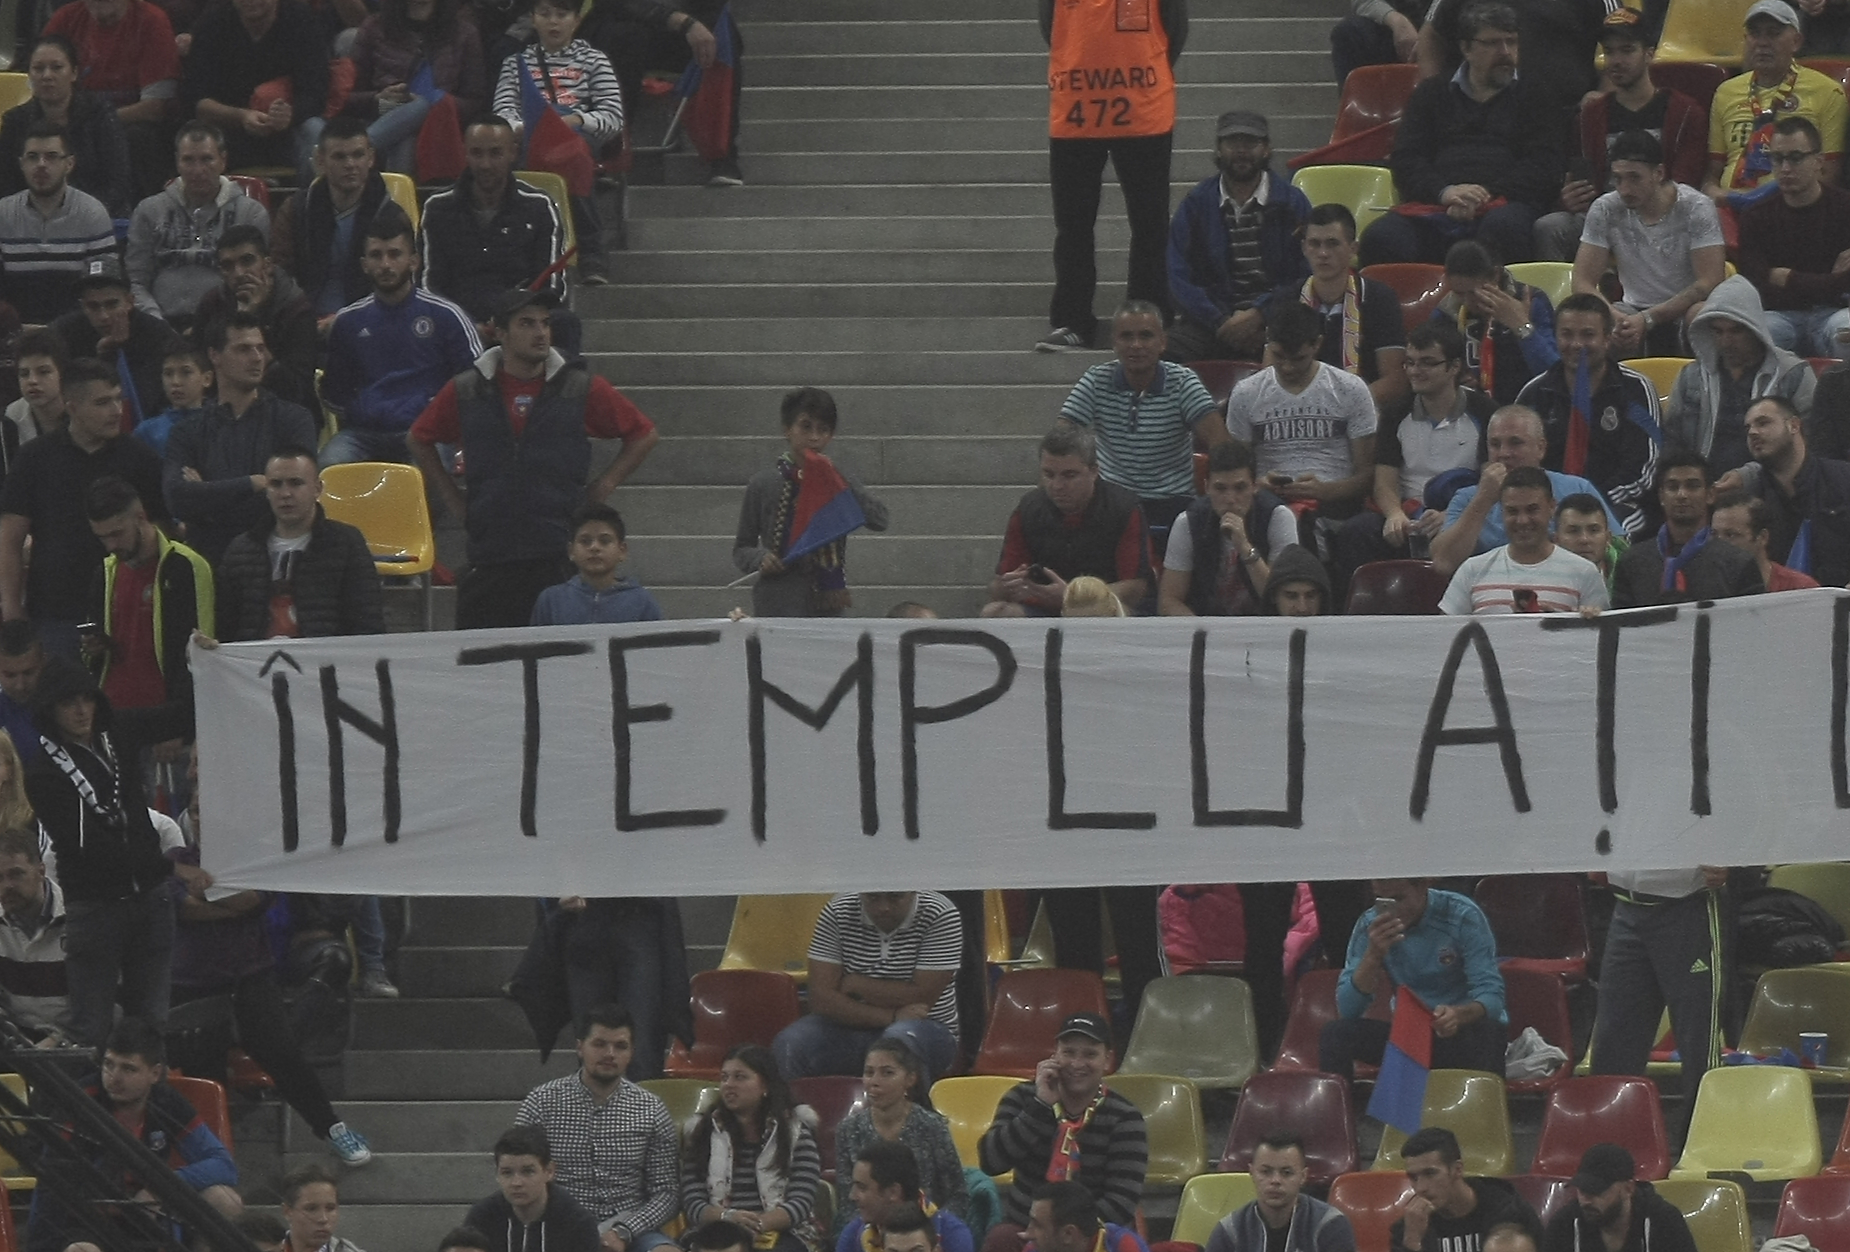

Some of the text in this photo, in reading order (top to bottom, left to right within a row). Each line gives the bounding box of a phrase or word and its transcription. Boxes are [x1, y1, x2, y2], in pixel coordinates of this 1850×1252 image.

[1049, 66, 1158, 91] STEWARD
[1066, 96, 1131, 128] 472
[1263, 419, 1334, 440] ADVISORY
[457, 628, 1307, 842] TEMPLU
